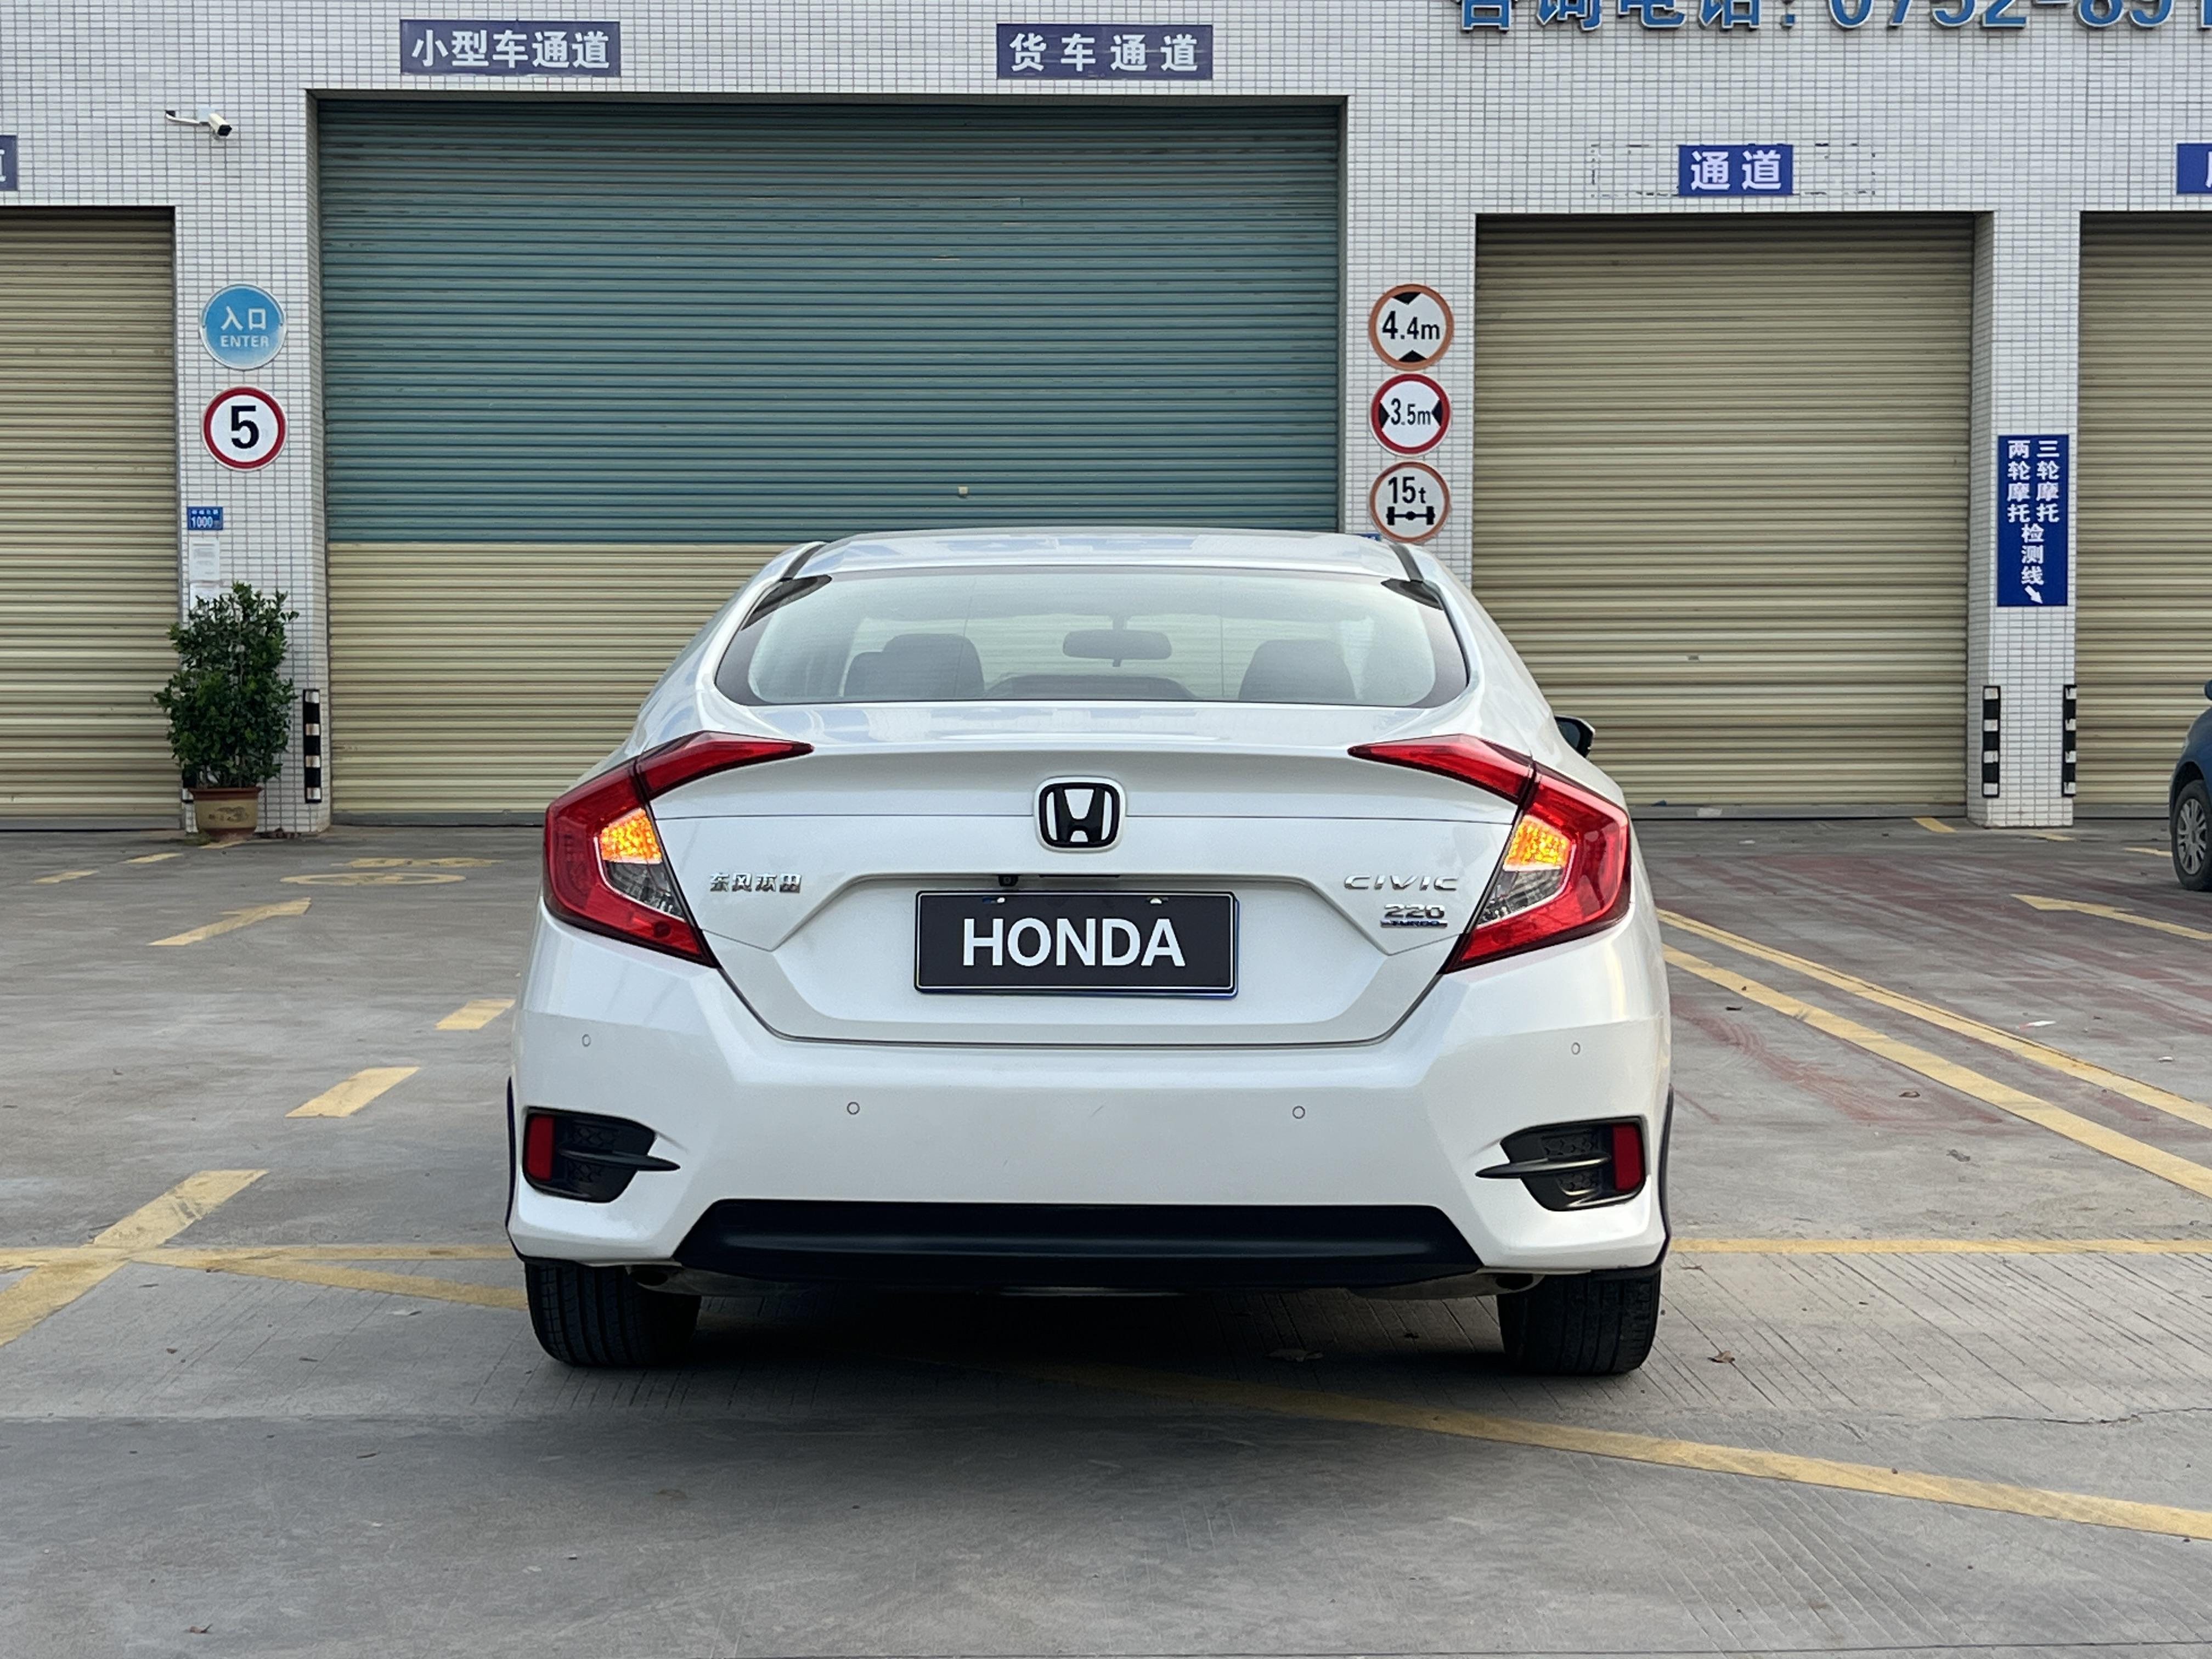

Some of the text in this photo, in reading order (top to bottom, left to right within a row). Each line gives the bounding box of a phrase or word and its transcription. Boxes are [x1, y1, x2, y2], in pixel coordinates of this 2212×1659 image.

[411, 30, 610, 69] 小型车通道
[1009, 33, 1198, 72] 货车通道
[1691, 150, 1781, 190] 通道
[221, 306, 267, 331] 入口
[1382, 311, 1440, 340] 4.4m
[221, 335, 269, 348] ENTER
[1391, 398, 1431, 425] 3.5m
[231, 405, 259, 449] 5
[1388, 477, 1426, 504] 15t
[2007, 441, 2030, 522] 两轮摩托
[2036, 441, 2059, 522] 三轮摩托
[191, 516, 213, 528] 1000
[2021, 523, 2044, 585] 检测线
[710, 872, 802, 893] 东风本田
[1344, 875, 1458, 891] CIVIC
[1384, 904, 1445, 919] 220
[963, 918, 1186, 967] HONDA
